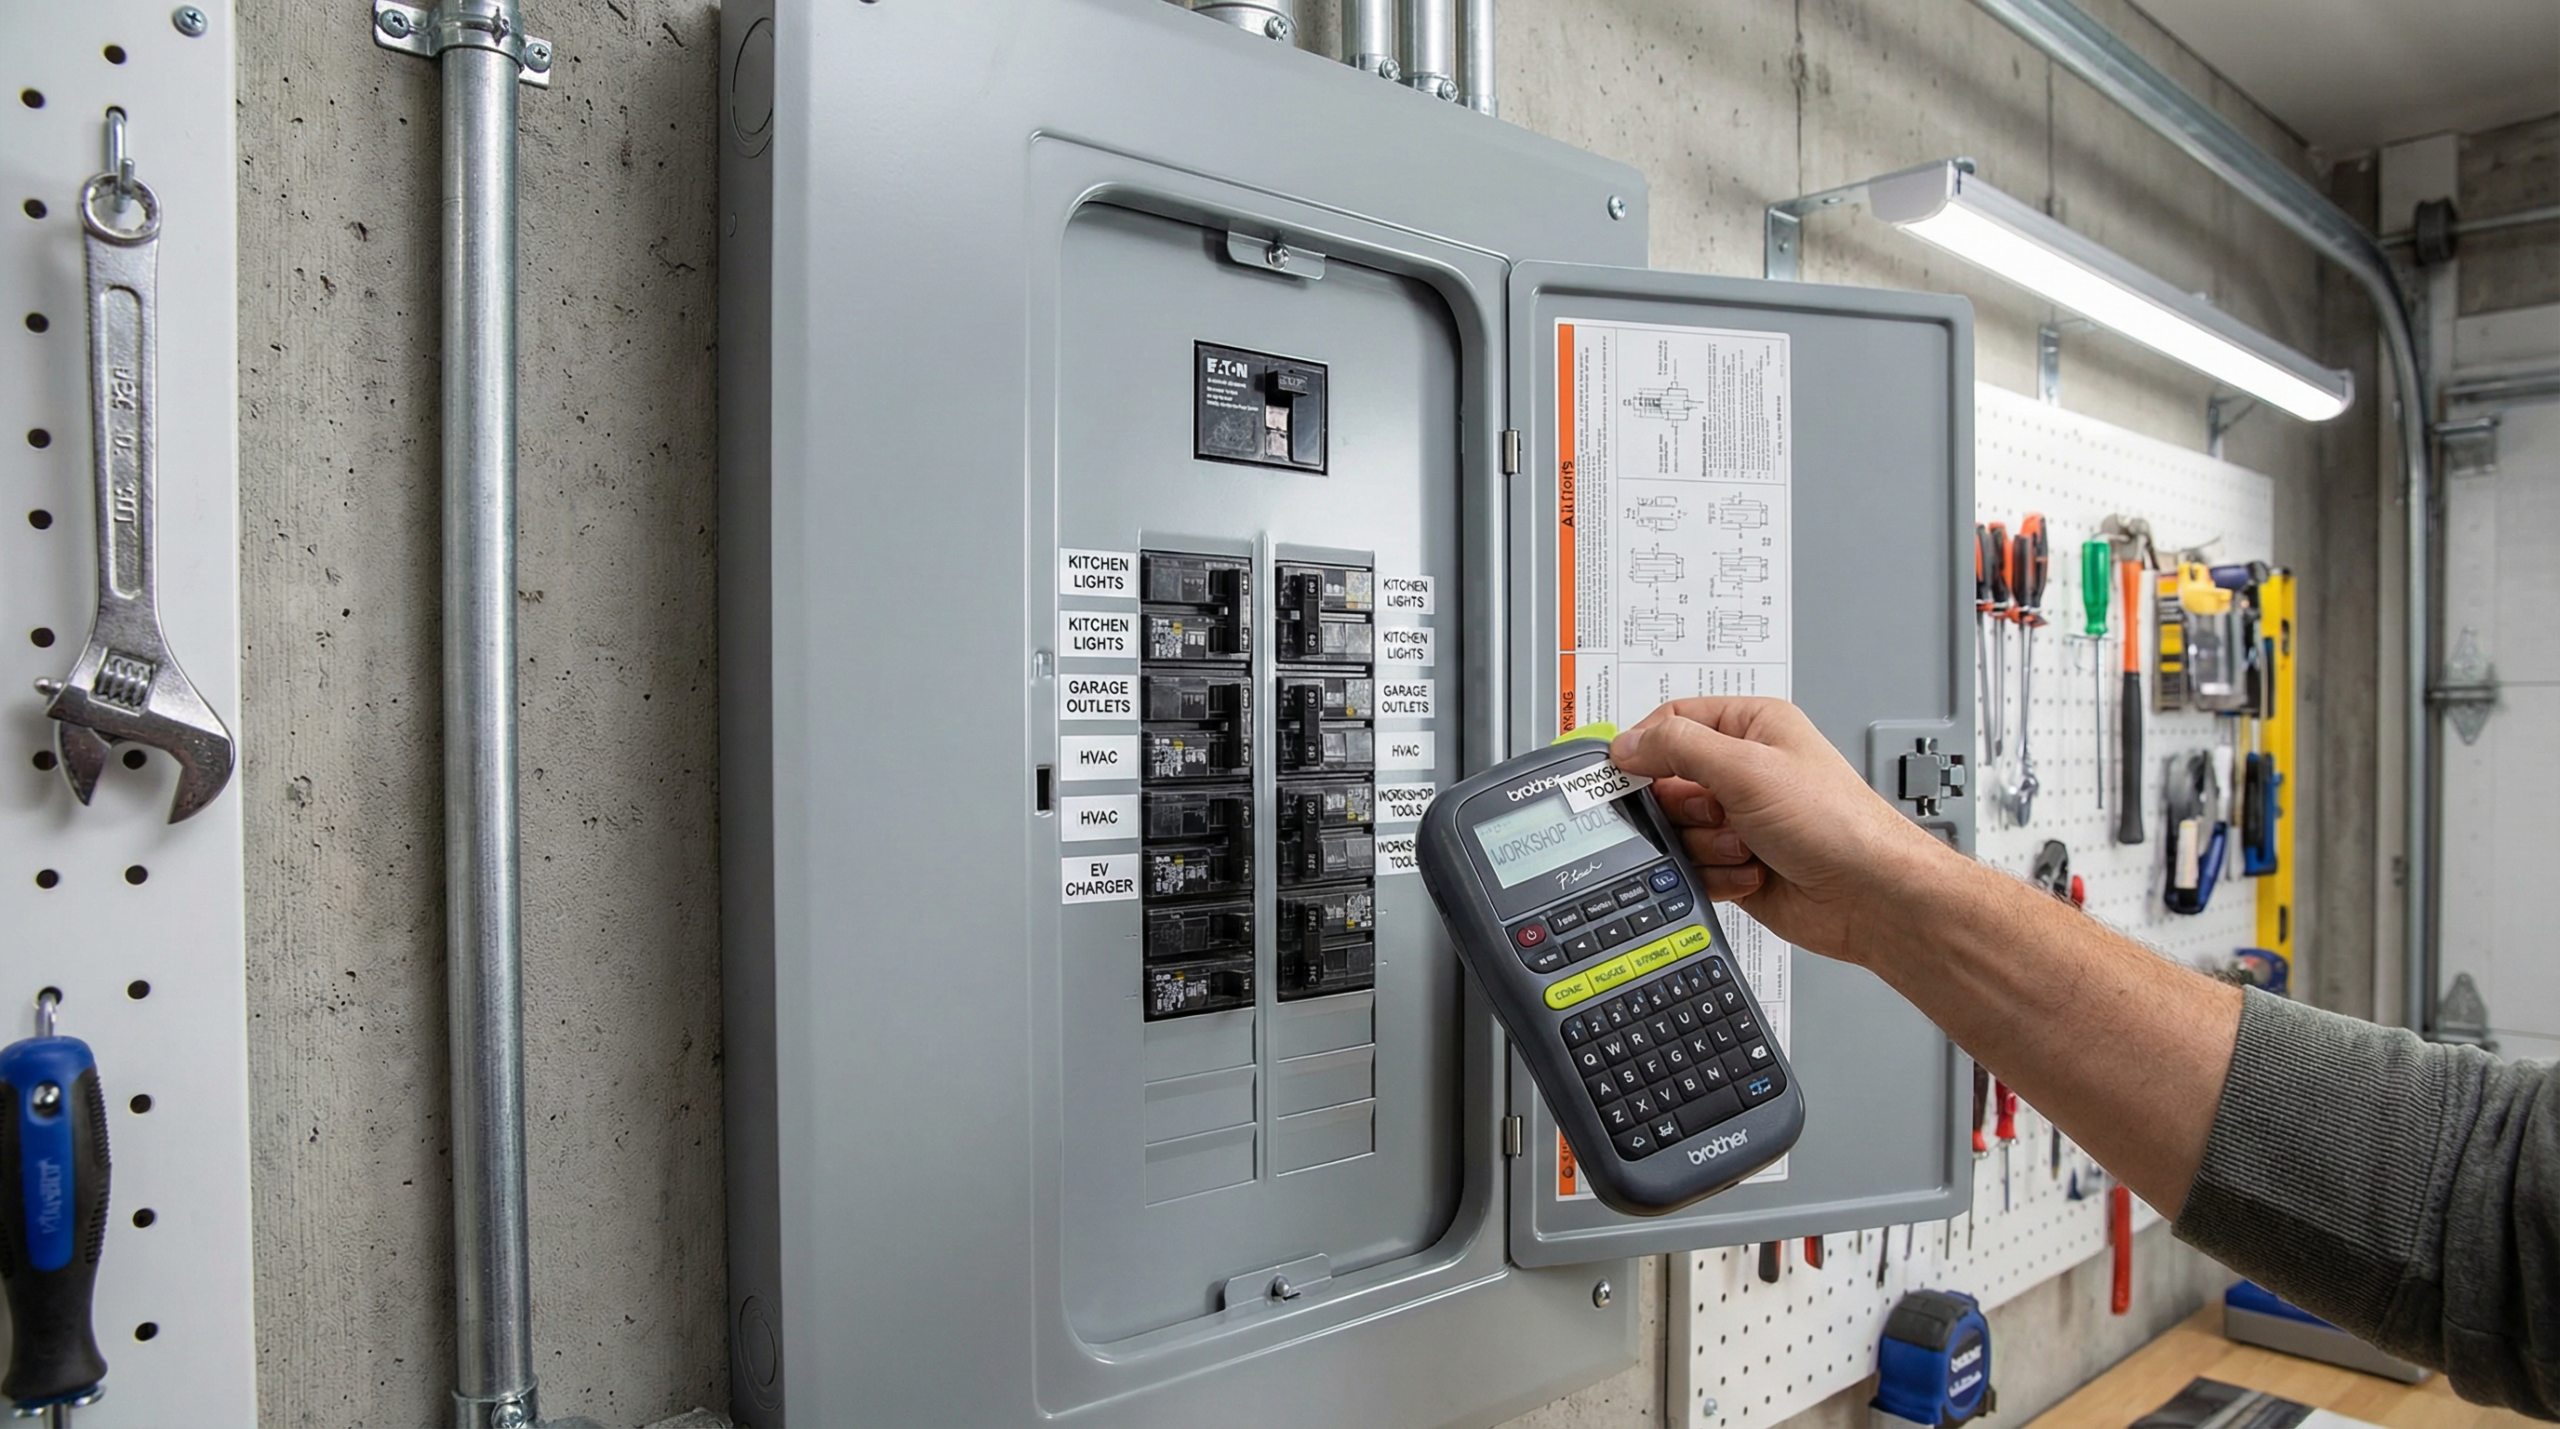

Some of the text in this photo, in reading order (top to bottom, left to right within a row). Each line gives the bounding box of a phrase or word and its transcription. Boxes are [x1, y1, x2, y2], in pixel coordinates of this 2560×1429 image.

[1207, 357, 1248, 379] EATON
[1068, 555, 1129, 572] KITCHEN
[1073, 574, 1124, 590] LIGHTS
[1383, 578, 1428, 593] KITCHEN
[1387, 595, 1424, 608] LIGHTS
[1068, 617, 1129, 633] KITCHEN
[1073, 636, 1124, 651] LIGHTS
[1383, 631, 1428, 644] KITCHEN
[1387, 647, 1424, 660] LIGHTS
[1068, 680, 1129, 695] GARAGE
[1383, 685, 1428, 697] GARAGE
[1066, 698, 1131, 713] OUTLETS
[1382, 701, 1430, 713] OUTLETS
[1079, 749, 1118, 765] HVAC
[1391, 744, 1420, 757] HVAC
[1563, 765, 1621, 793] WORKSH
[1585, 776, 1630, 800] TOOLS
[1080, 809, 1119, 826] HVAC
[1391, 804, 1423, 817] TOOLS
[1491, 822, 1567, 866] WORKSHOP
[1570, 805, 1619, 835] TOOLS
[1377, 840, 1416, 854] WORKS
[1090, 862, 1109, 877] EV
[1065, 878, 1134, 897] CHARGER
[1571, 1030, 1579, 1040] 1
[1591, 1022, 1600, 1032] 2
[1612, 1012, 1621, 1023] 3
[1673, 986, 1681, 996] 6
[1584, 992, 1734, 1065] Q W R T U O P
[1601, 1031, 1728, 1095] A S F G K L
[1612, 1109, 1624, 1123] Z
[1636, 1098, 1649, 1113] X
[1660, 1087, 1670, 1101] V
[1684, 1078, 1695, 1091] B
[1707, 1067, 1720, 1080] N
[1687, 1128, 1748, 1165] brother
